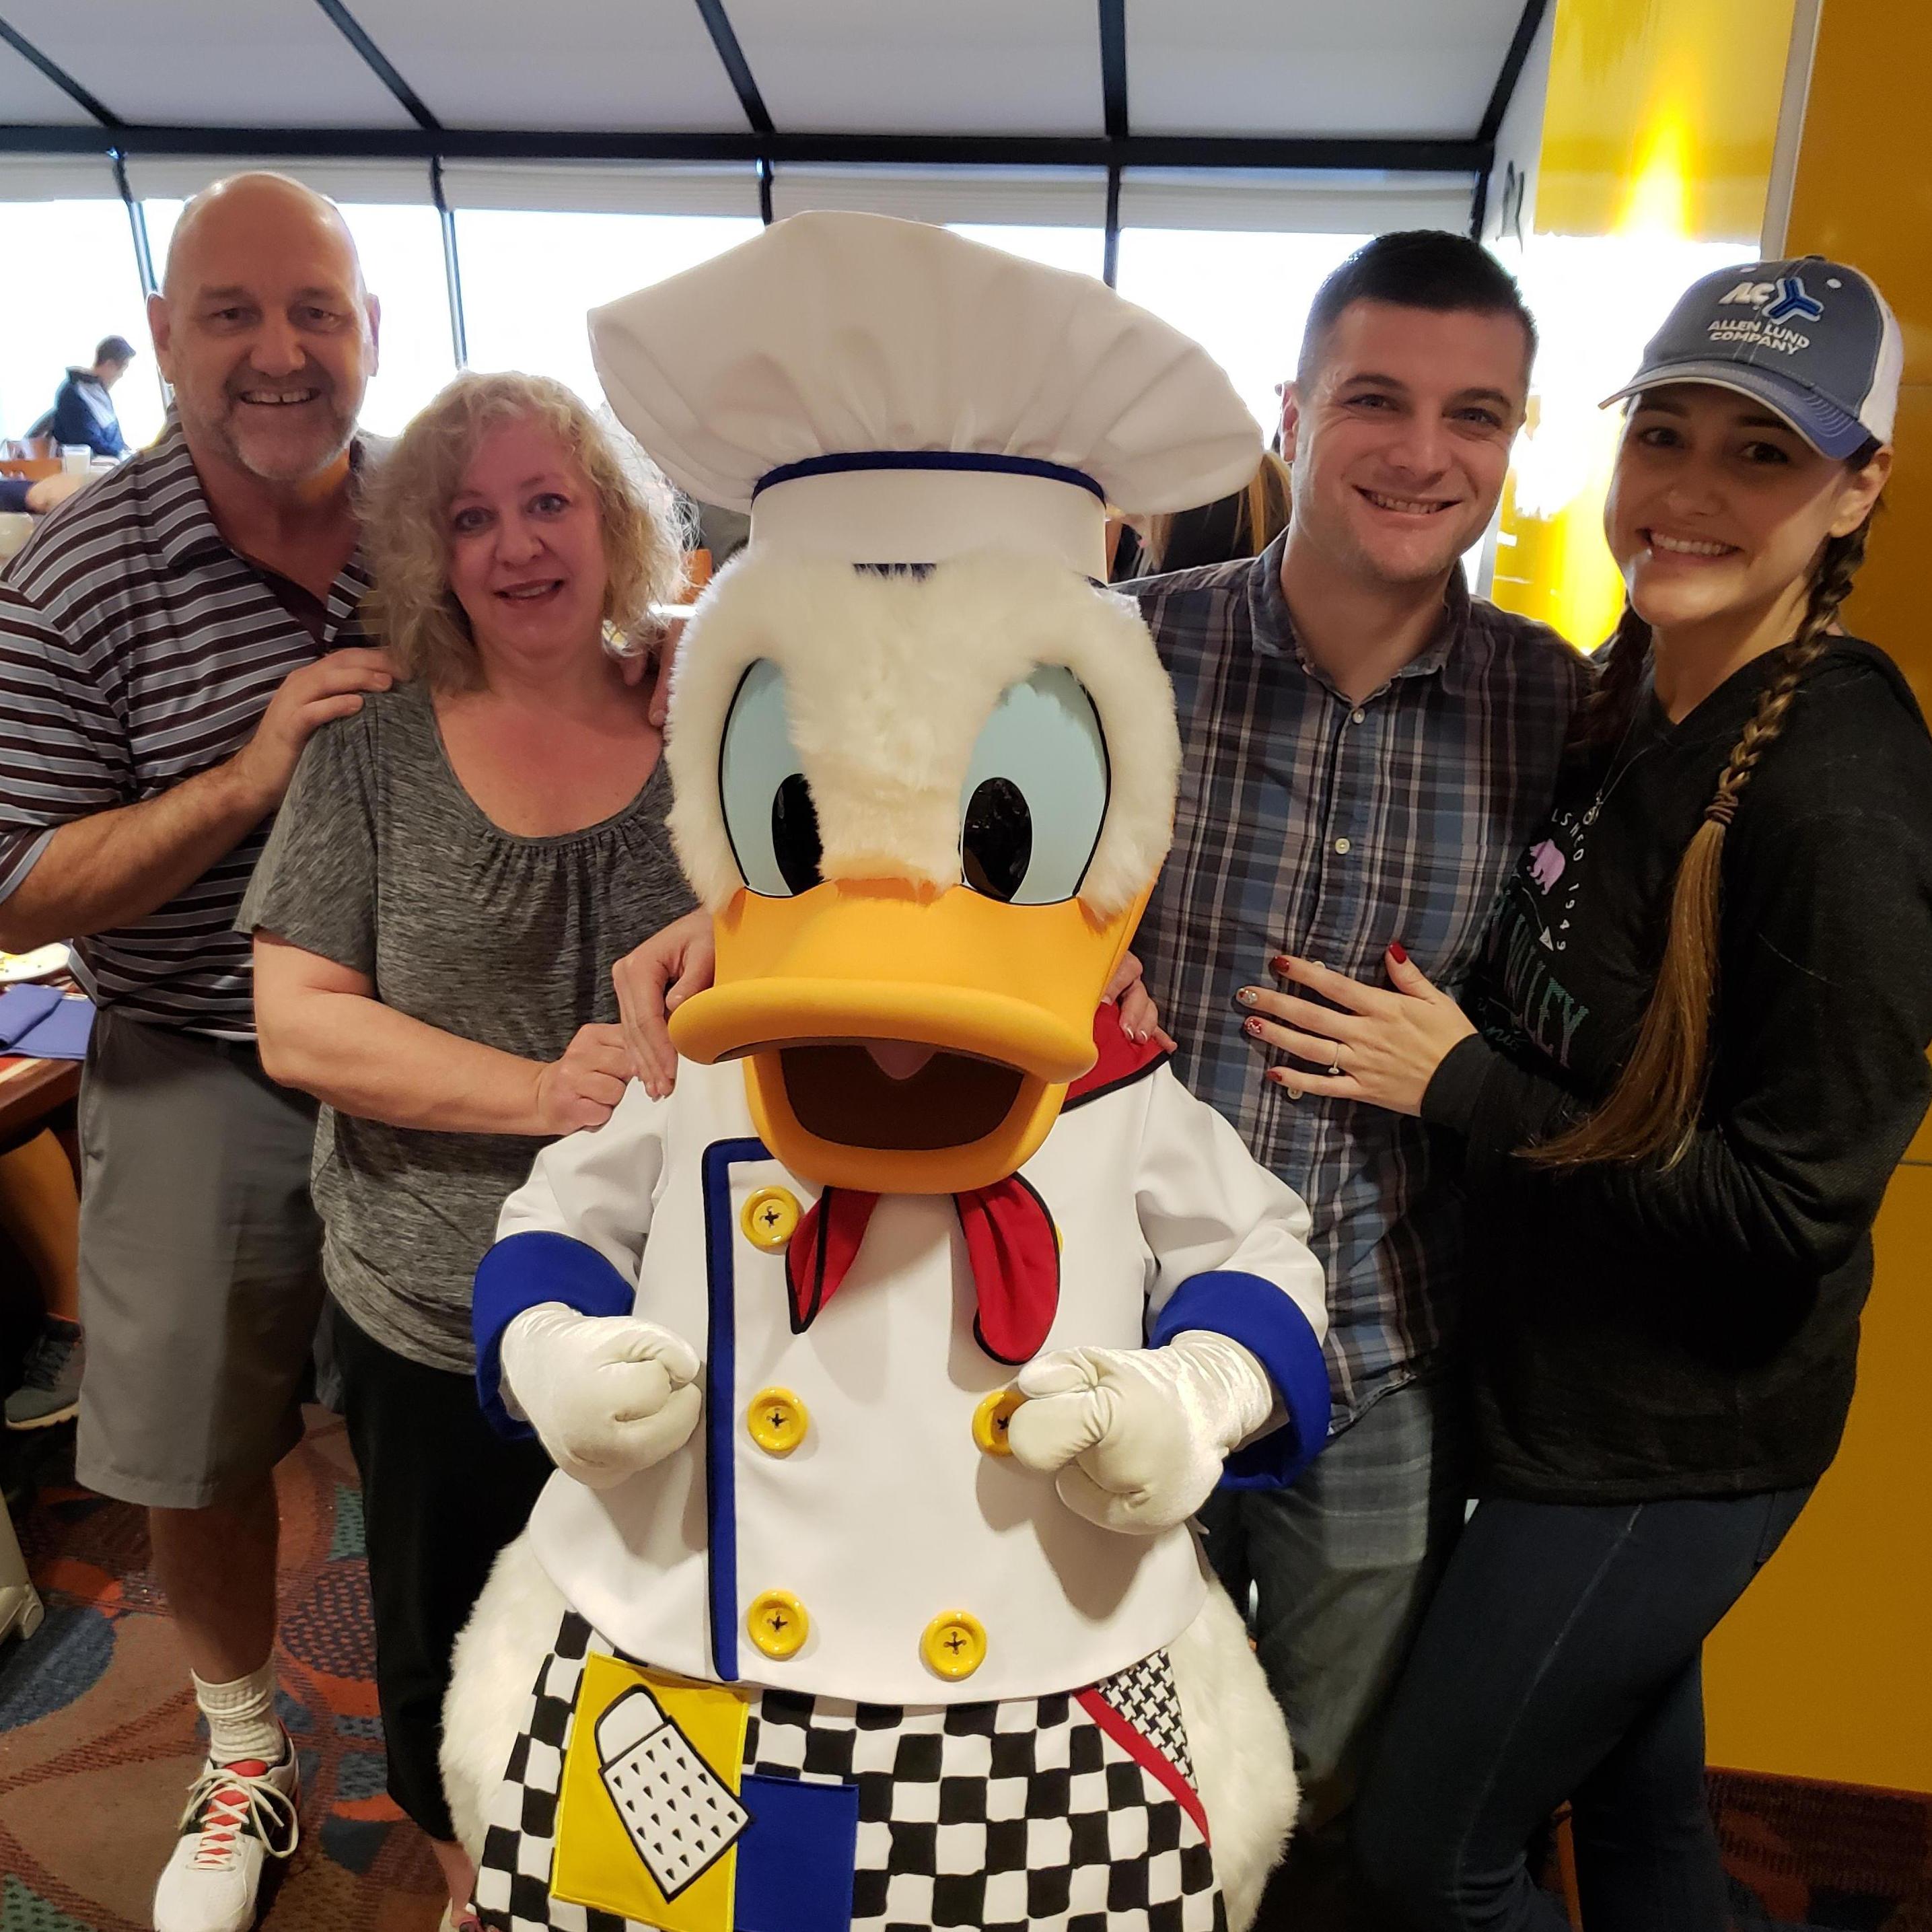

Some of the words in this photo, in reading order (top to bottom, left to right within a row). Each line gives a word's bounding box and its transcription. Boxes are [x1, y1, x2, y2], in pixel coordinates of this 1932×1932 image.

[1707, 320, 1762, 332] ALLEN
[1763, 324, 1810, 349] LUND
[1709, 331, 1801, 355] COMPANY
[1557, 882, 1580, 951] 1949
